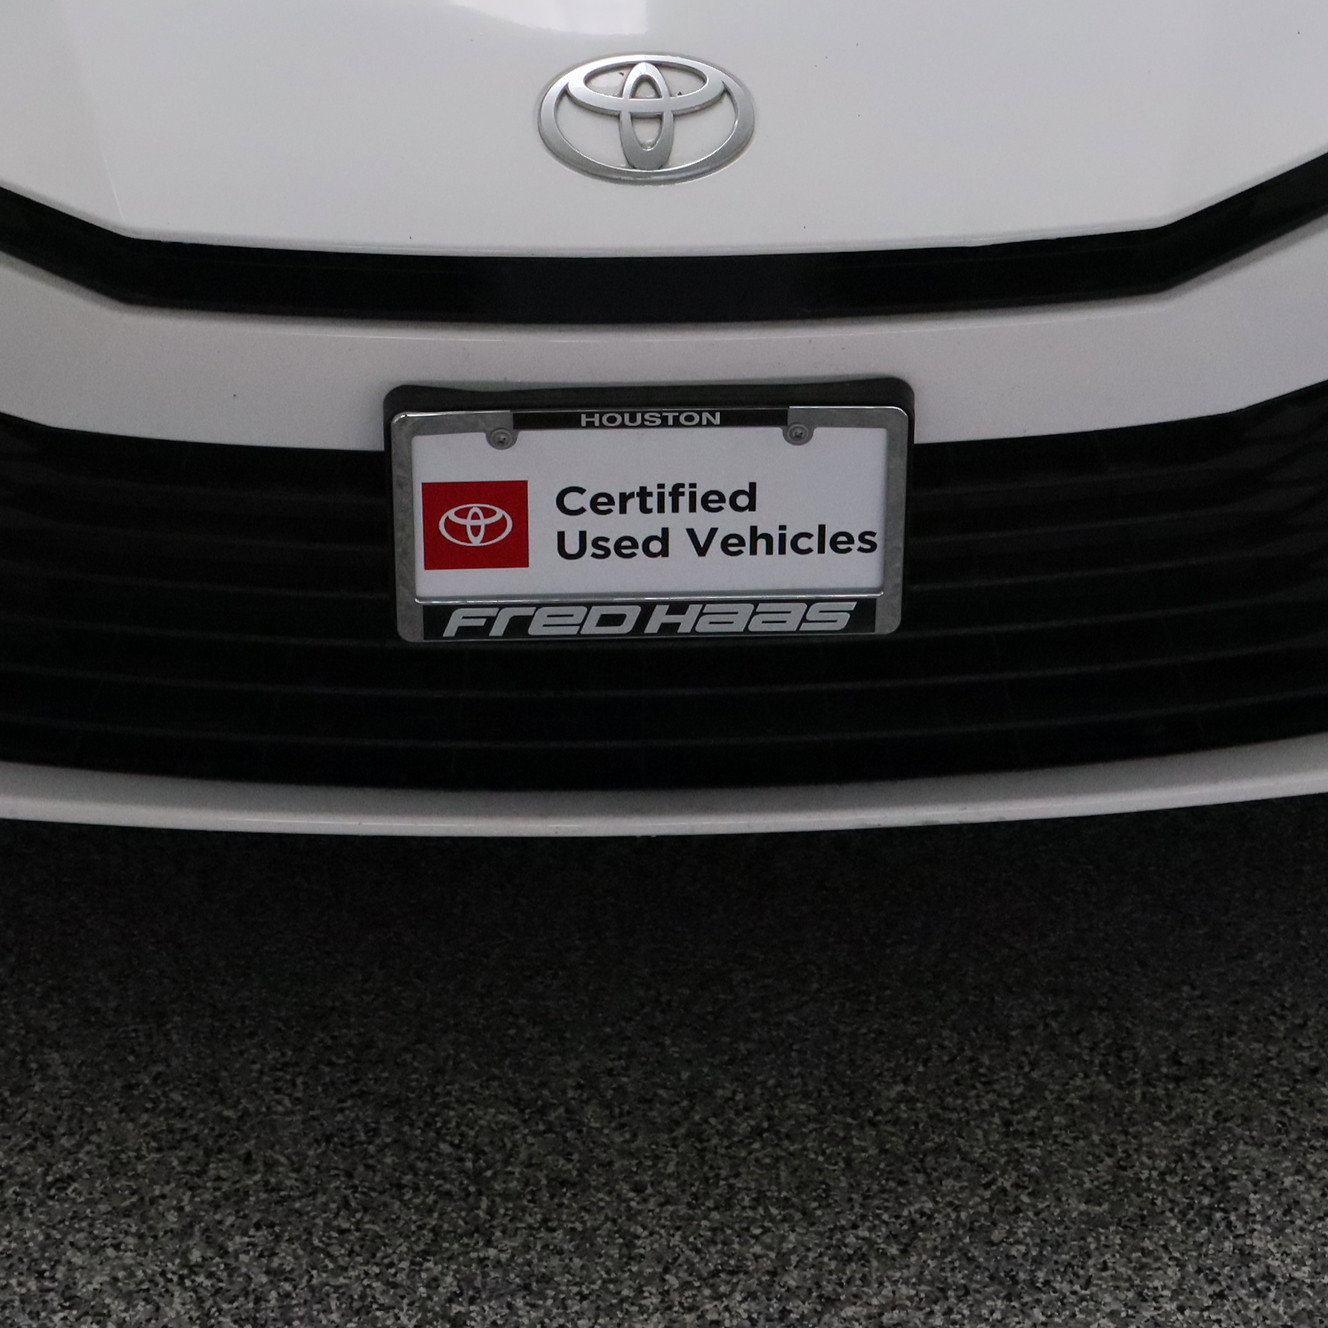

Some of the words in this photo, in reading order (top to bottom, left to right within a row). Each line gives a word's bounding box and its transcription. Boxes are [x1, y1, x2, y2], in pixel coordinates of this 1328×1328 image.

[579, 410, 722, 428] HOUSTON
[554, 481, 758, 516] Certified
[554, 527, 671, 560] Used
[685, 523, 879, 558] Vehicles
